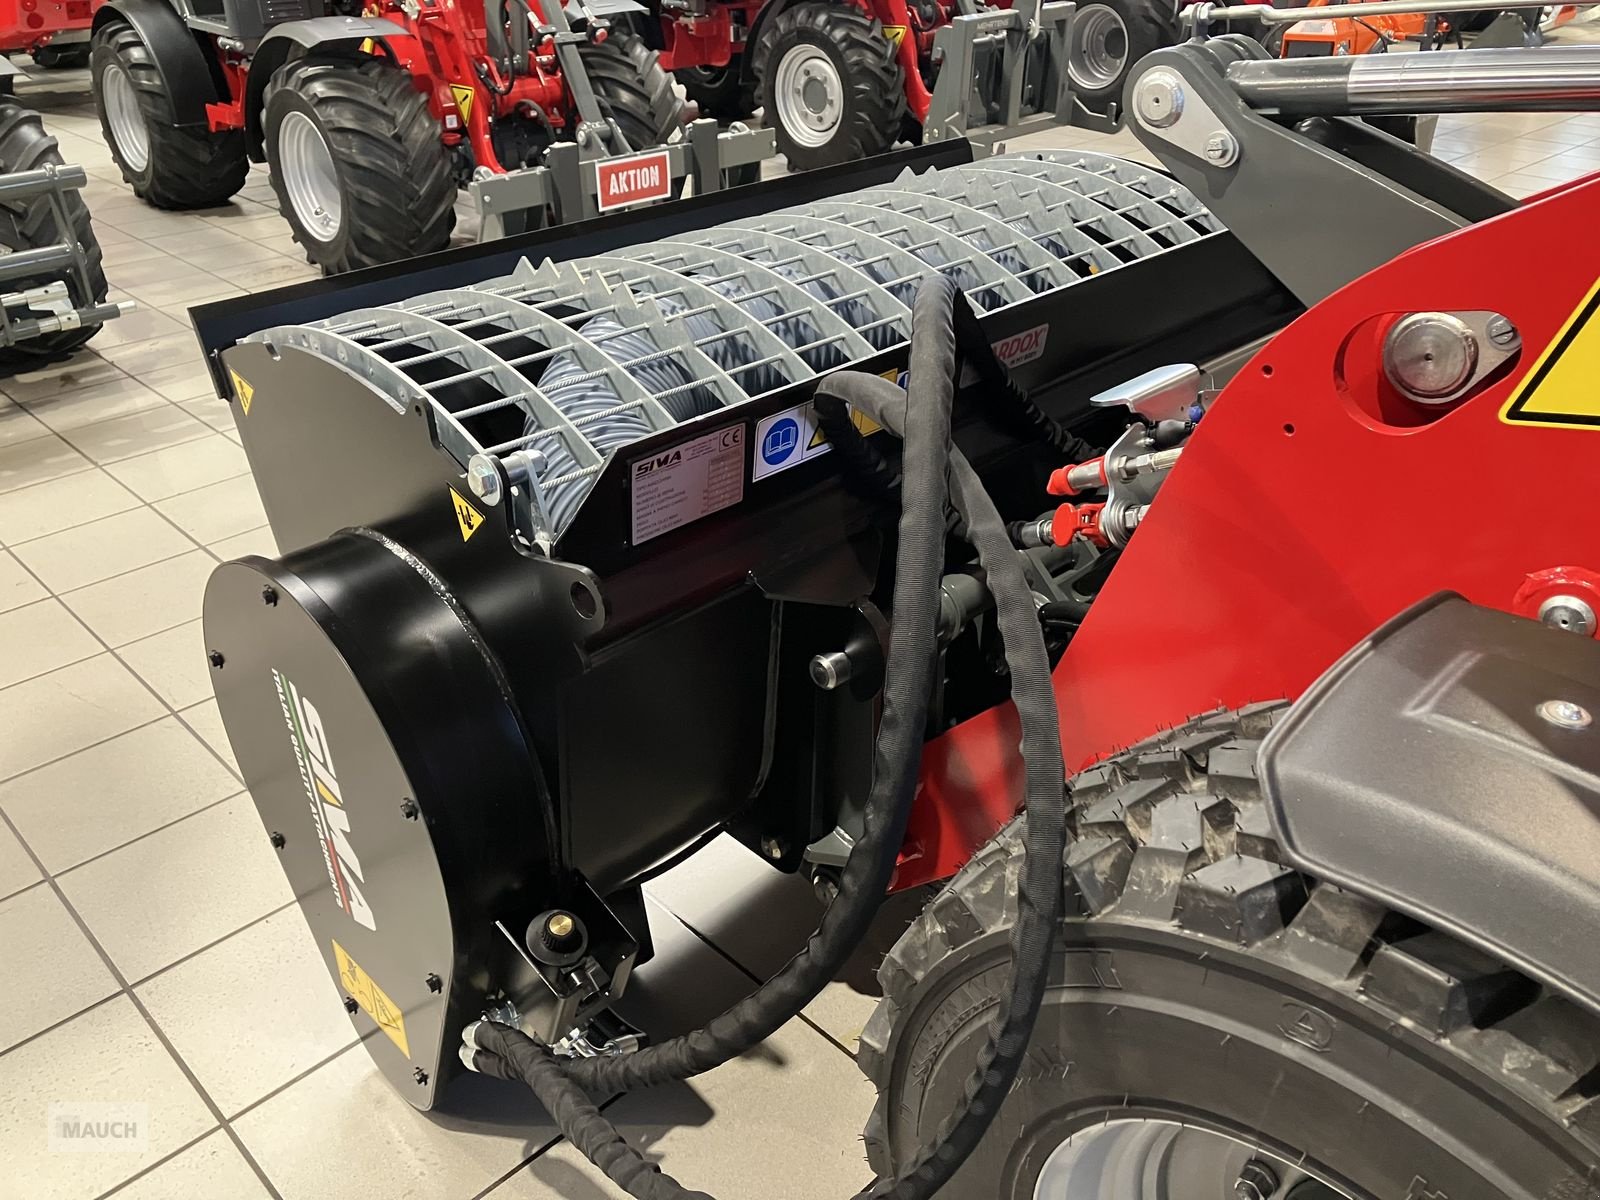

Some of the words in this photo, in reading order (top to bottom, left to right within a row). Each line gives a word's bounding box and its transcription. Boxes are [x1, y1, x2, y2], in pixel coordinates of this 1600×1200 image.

[609, 165, 660, 196] AKTION
[635, 451, 681, 476] SIMA
[271, 668, 295, 732] ITALIAN
[290, 733, 314, 801] QUALITY
[309, 801, 344, 909] ATTACHMENTS
[288, 680, 376, 931] SIMA
